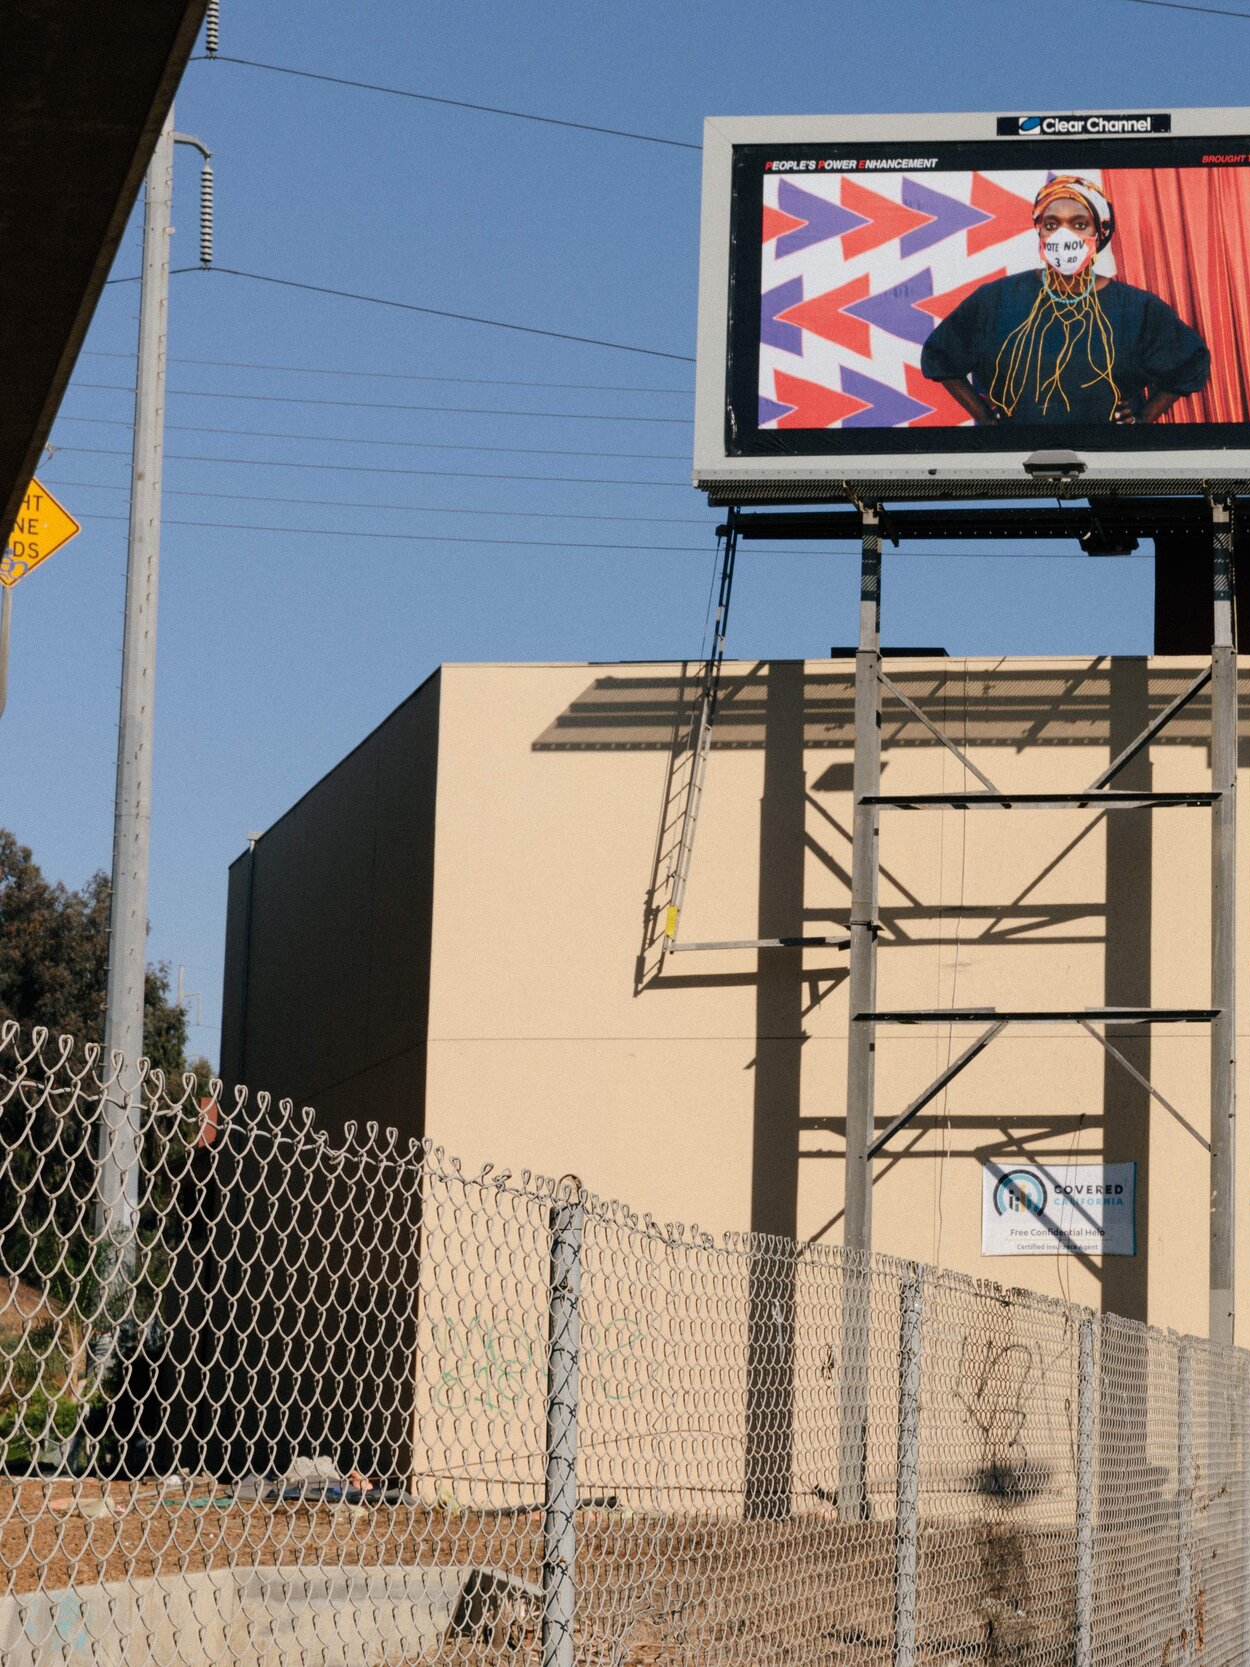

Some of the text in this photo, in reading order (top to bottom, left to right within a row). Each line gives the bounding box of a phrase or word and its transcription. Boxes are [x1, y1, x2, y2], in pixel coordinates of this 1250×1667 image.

[1042, 116, 1151, 133] Clear Channel
[1202, 154, 1246, 163] BROUGHT
[765, 158, 938, 170] PEOPLE'S POWER ENHANCEMENT
[1055, 257, 1061, 268] 3
[1054, 1184, 1124, 1195] COVERED
[1054, 1197, 1124, 1206] CALIFORNIA
[1030, 1228, 1083, 1236] Confidential
[1078, 1243, 1098, 1252] Agent
